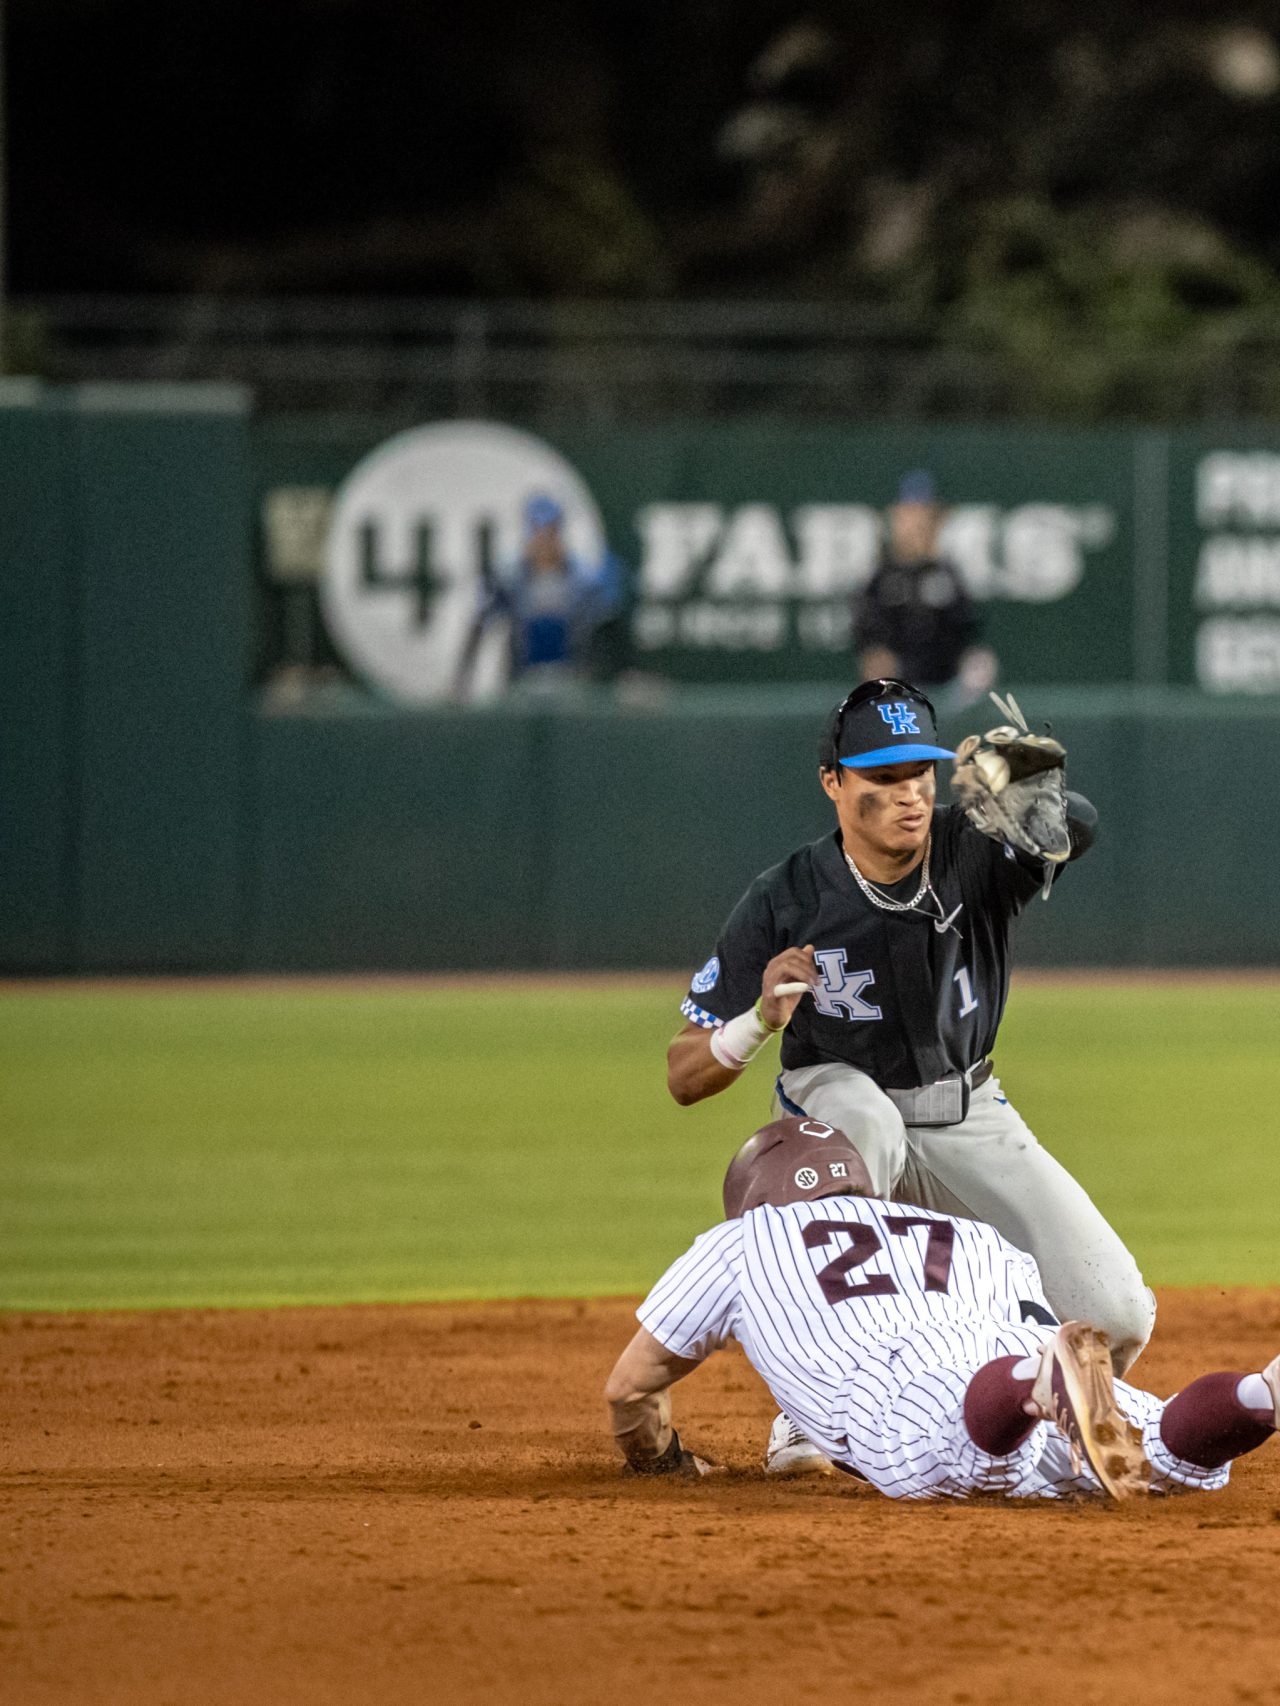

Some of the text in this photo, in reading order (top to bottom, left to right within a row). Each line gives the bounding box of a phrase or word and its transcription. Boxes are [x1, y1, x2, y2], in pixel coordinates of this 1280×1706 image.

[877, 703, 921, 735] UK
[953, 966, 978, 1019] 1
[828, 1162, 848, 1178] 27
[801, 1215, 955, 1305] 27
